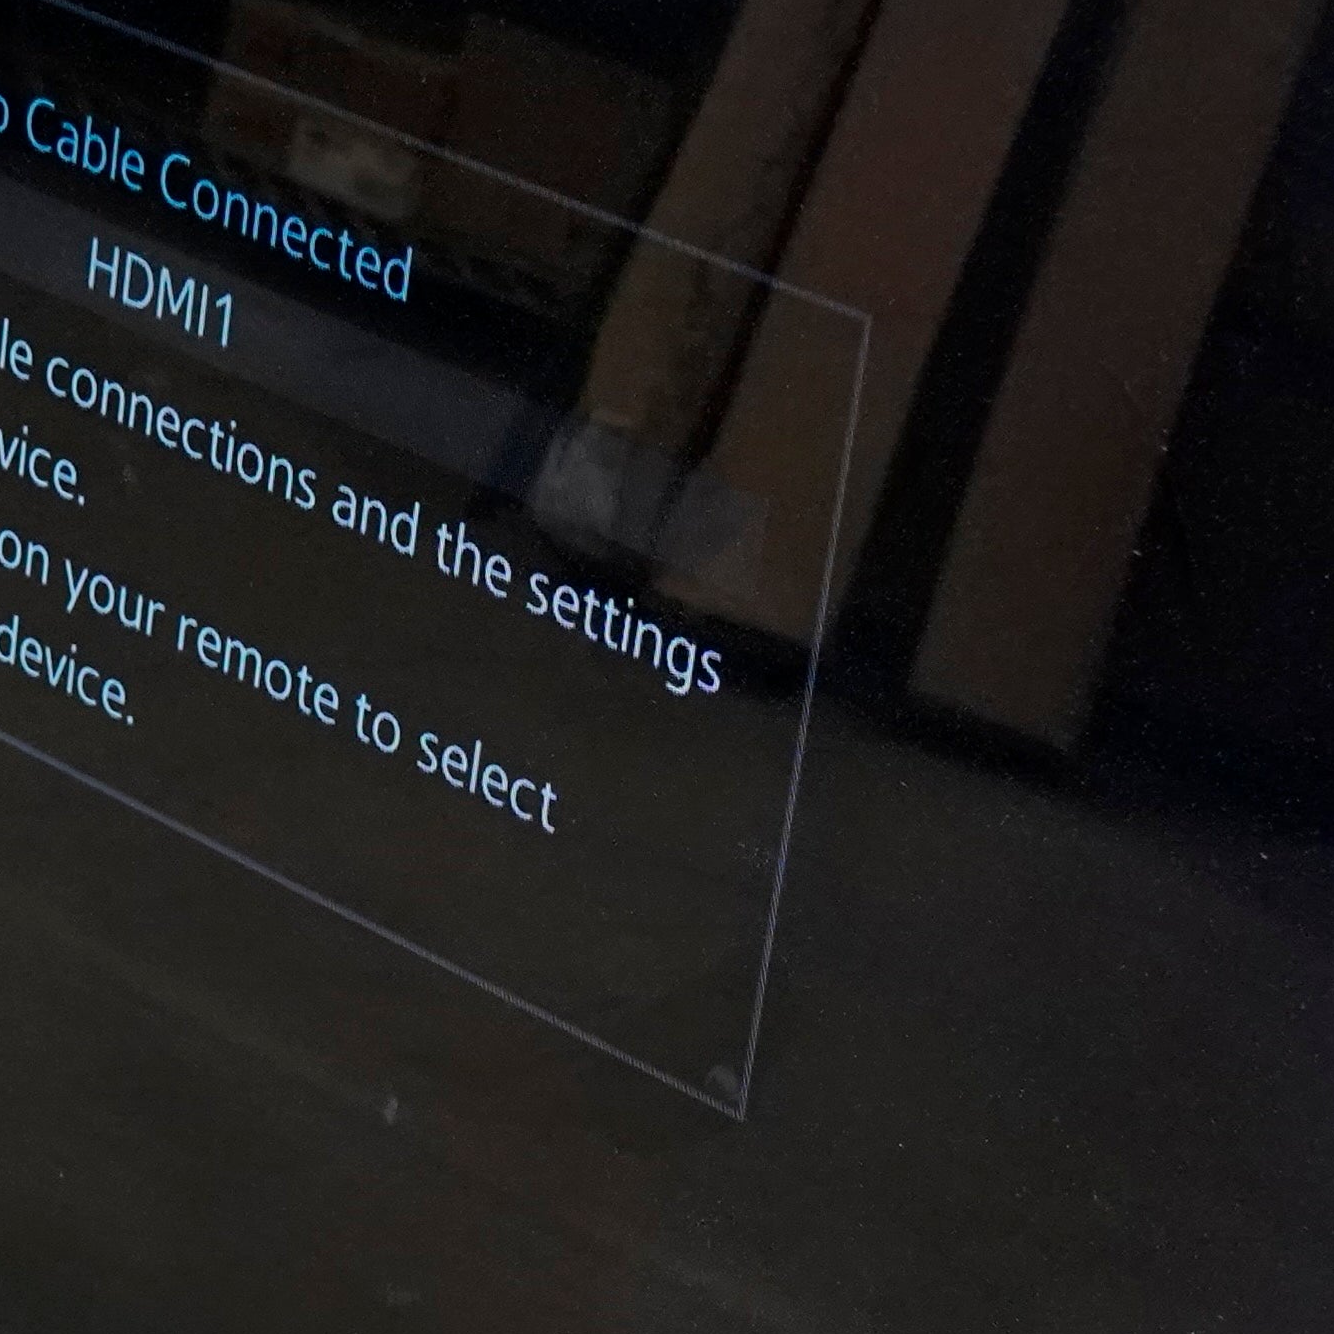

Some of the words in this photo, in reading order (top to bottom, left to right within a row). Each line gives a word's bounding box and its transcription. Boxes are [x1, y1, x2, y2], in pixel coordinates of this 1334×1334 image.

[26, 97, 145, 191] Cable
[160, 153, 413, 302] Connected
[87, 237, 232, 348] HDMI1
[46, 357, 316, 510] connections
[332, 484, 421, 557] and
[436, 521, 512, 598] the
[526, 572, 722, 696] settings
[65, 559, 166, 636] your
[177, 614, 339, 725] remote
[355, 693, 401, 753] to
[416, 732, 558, 834] select
